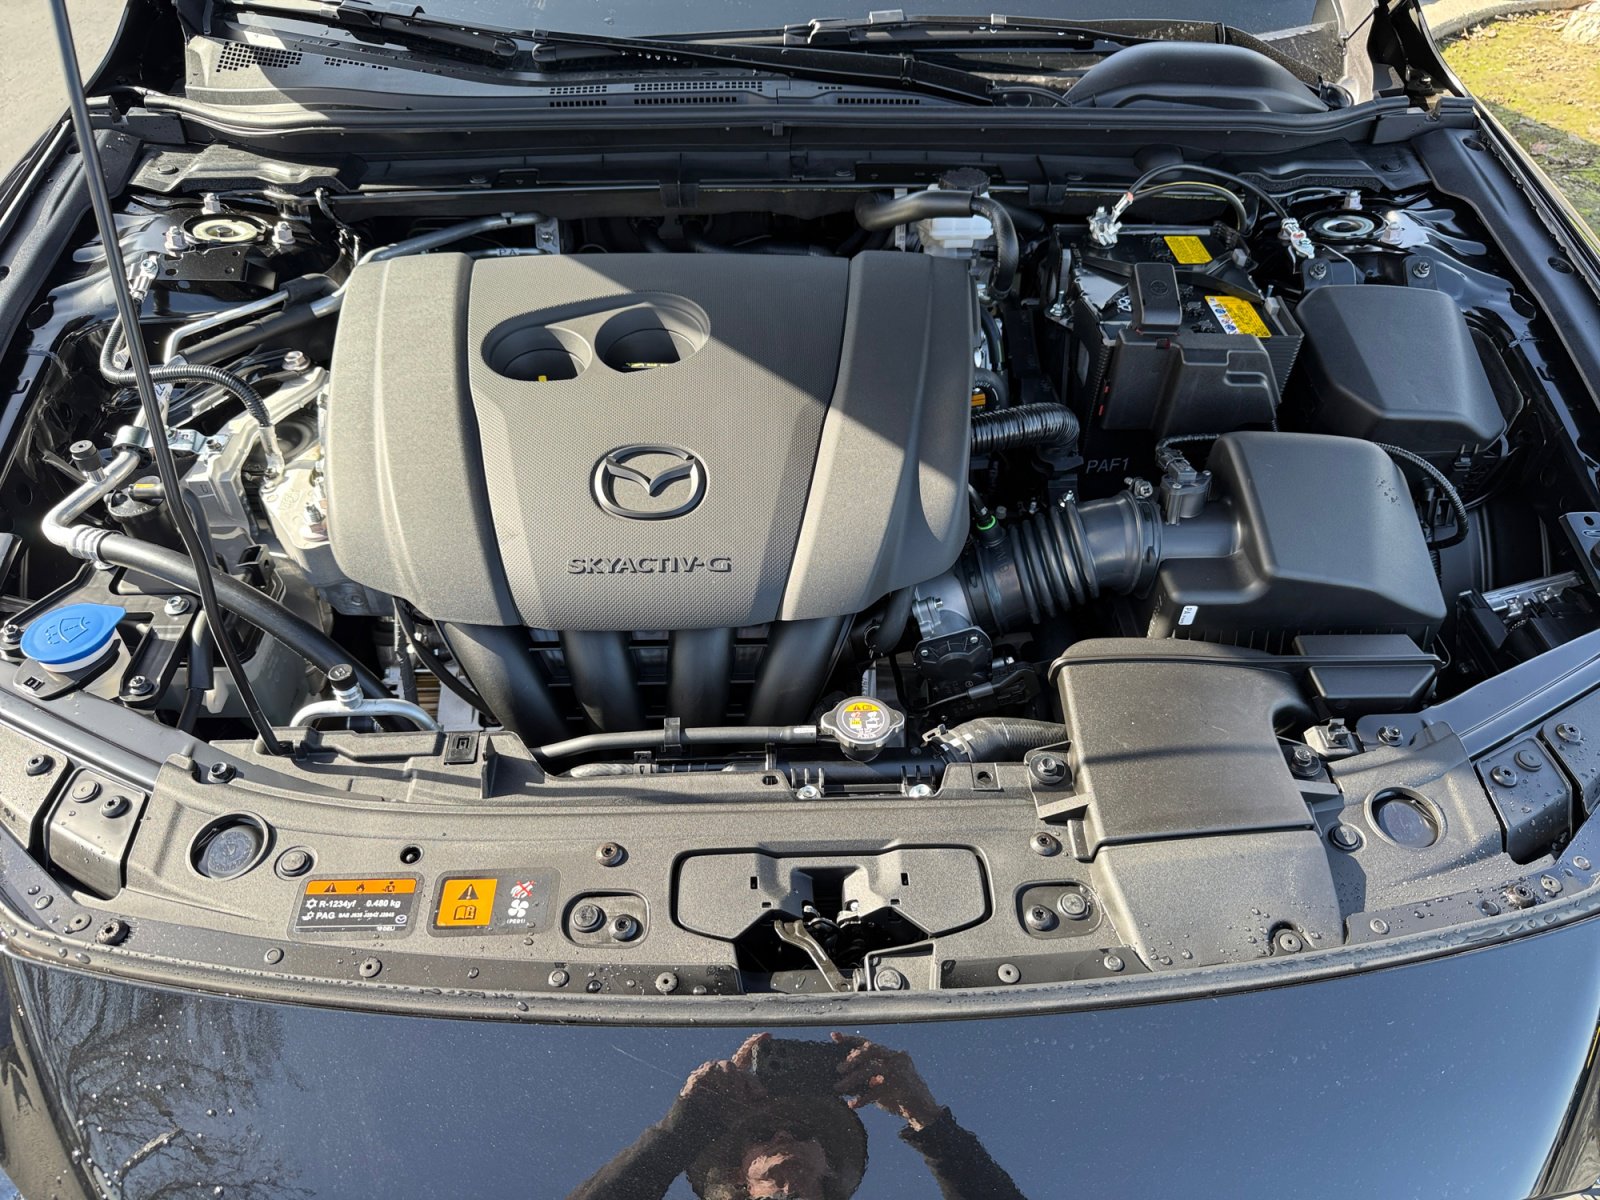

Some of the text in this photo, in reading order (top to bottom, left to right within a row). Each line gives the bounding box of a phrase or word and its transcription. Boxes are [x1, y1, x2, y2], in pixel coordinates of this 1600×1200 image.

[1085, 457, 1129, 474] PAF1
[567, 556, 732, 575] SKYACTIV-G
[319, 899, 401, 909] R-1234yf 0.480 kg
[315, 911, 336, 920] PAG
